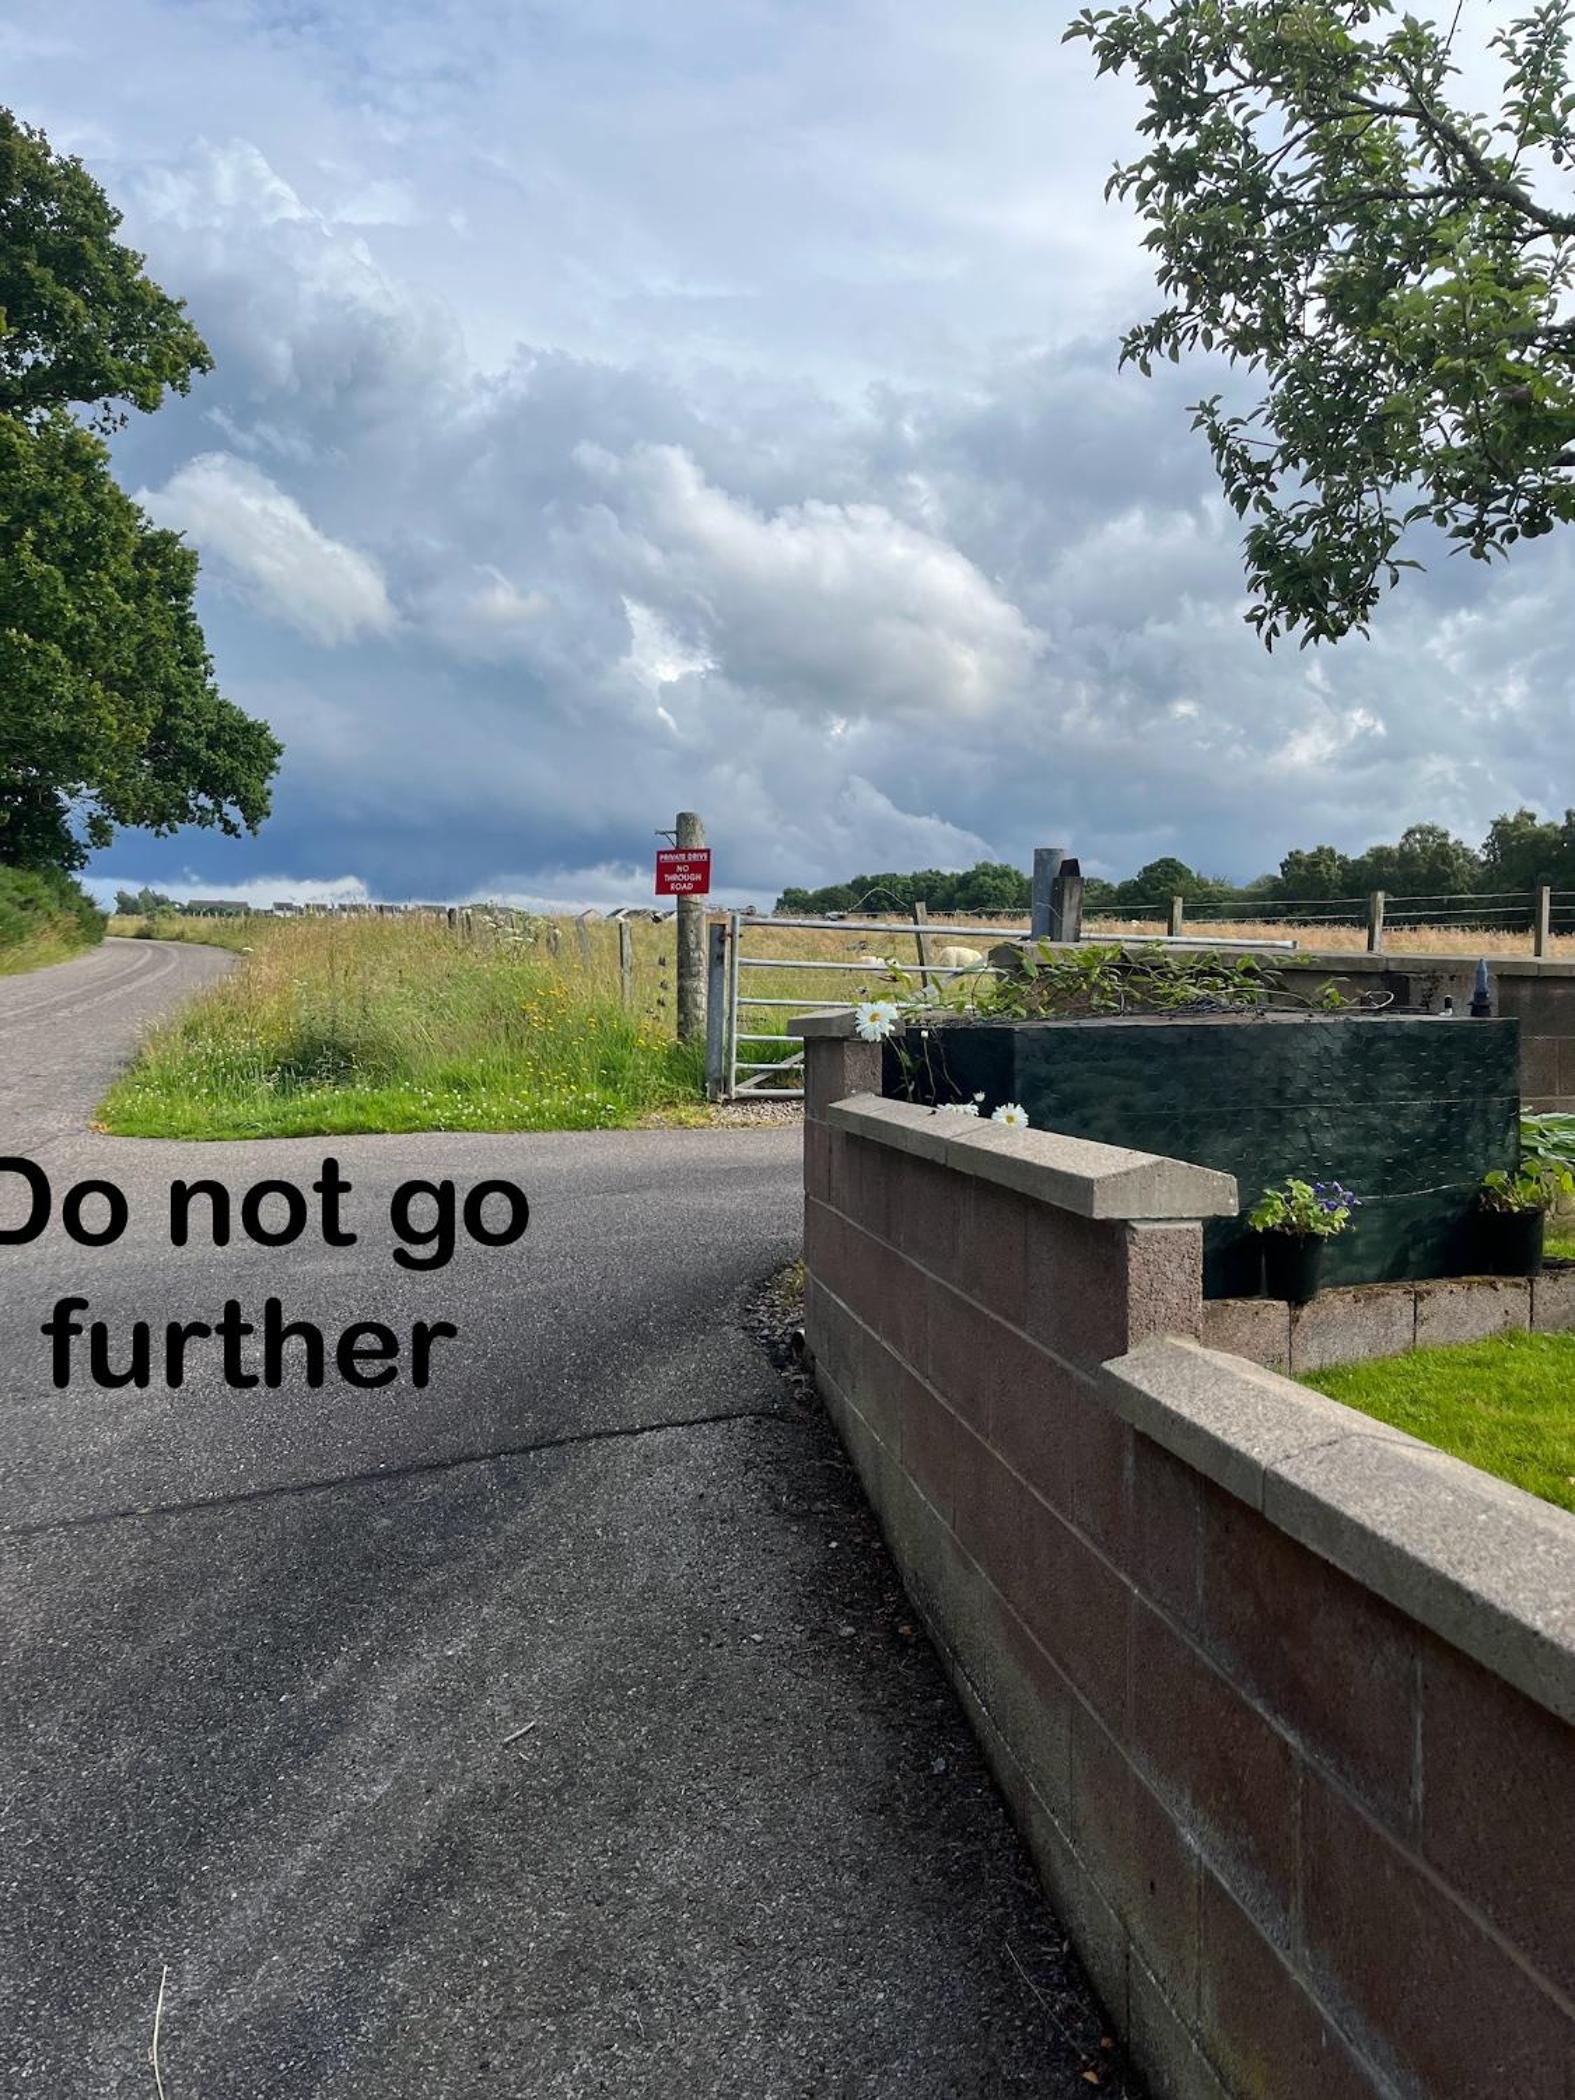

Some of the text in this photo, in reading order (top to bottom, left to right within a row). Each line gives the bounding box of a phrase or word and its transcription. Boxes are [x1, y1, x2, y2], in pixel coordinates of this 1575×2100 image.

[659, 852, 708, 863] PRIVATE DRIVE
[664, 873, 702, 882] THROUGH
[670, 882, 694, 891] ROAD
